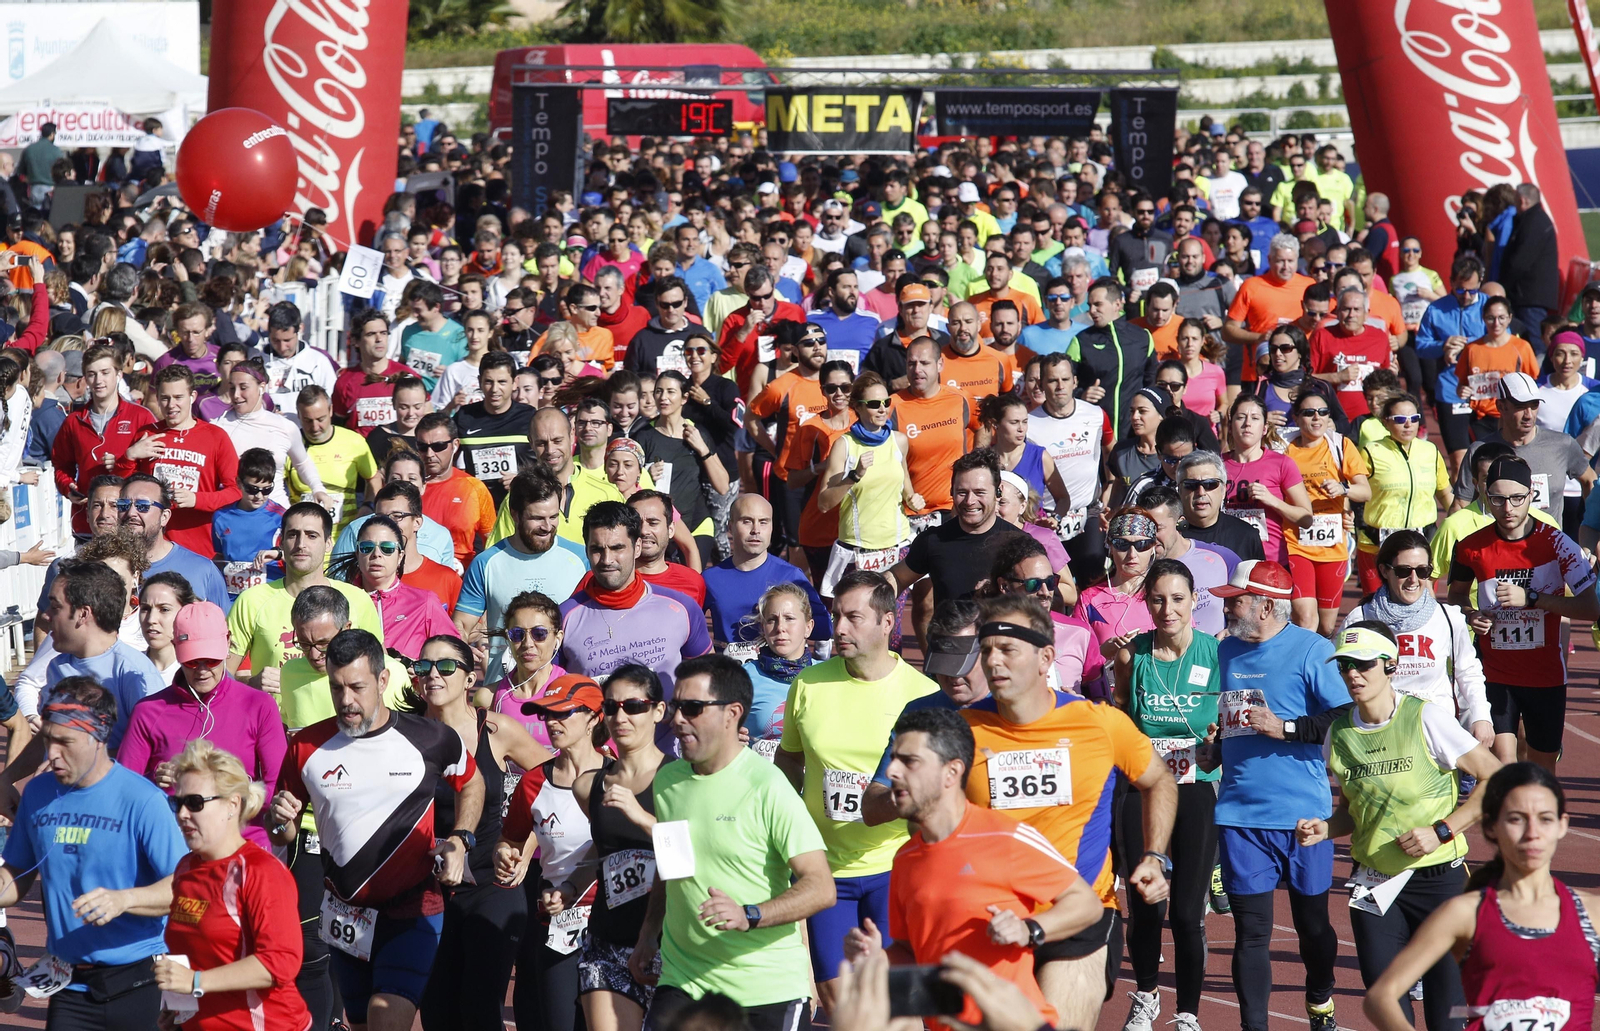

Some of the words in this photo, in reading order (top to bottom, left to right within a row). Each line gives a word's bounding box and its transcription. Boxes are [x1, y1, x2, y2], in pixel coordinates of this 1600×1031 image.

[766, 94, 913, 133] META
[945, 100, 1093, 118] www.temposport.es
[532, 92, 551, 175] Tempo
[1128, 97, 1148, 179] Tempo
[412, 358, 434, 373] 278
[960, 377, 993, 388] avanade
[363, 409, 392, 422] 4051
[920, 417, 957, 432] avanade
[1051, 449, 1092, 460] PEDREGALEJO
[481, 459, 510, 474] 330
[1306, 528, 1336, 542] 164
[863, 554, 895, 570] 4413
[1495, 568, 1535, 579] WHERE
[1496, 610, 1520, 621] CORRE
[1499, 626, 1534, 642] 111
[599, 645, 627, 658] Media
[629, 637, 667, 650] Maratón
[728, 641, 752, 653] CORRE
[599, 656, 630, 671] Carrera
[632, 645, 665, 660] Popular
[644, 653, 666, 666] 2017
[1147, 693, 1202, 709] aecc
[1222, 690, 1244, 704] CORRE
[998, 751, 1033, 767] CORRE
[829, 771, 858, 785] CORRE
[1002, 774, 1057, 798] 365
[54, 826, 92, 845] RUN
[555, 908, 582, 925] CORRE
[330, 918, 356, 944] 69
